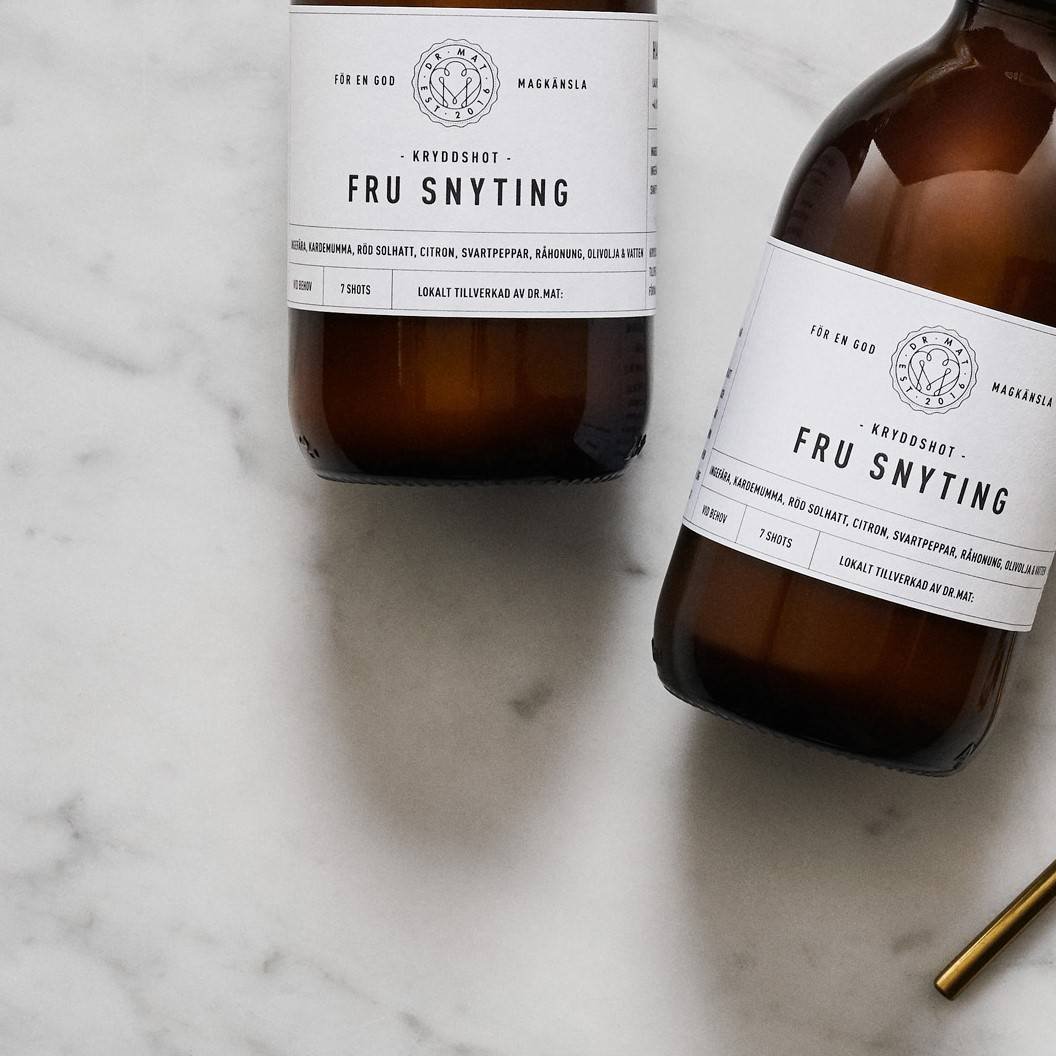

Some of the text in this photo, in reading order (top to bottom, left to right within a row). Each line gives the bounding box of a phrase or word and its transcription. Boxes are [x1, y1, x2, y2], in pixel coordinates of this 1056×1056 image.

[457, 47, 487, 70] MAT
[334, 72, 395, 86] FÖR EN GOD
[518, 76, 588, 90] MAGKÄNSLA
[421, 85, 440, 112] EST
[413, 150, 499, 164] KRYDDSHOT
[348, 174, 568, 207] FRU SNYTING
[357, 242, 373, 255] RÖD
[376, 245, 417, 258] SOLHATT,
[420, 247, 458, 259] CITRON,
[461, 248, 532, 260] SVARTPEPPAR,
[535, 245, 585, 260] RÅHONUNG,
[587, 248, 620, 259] OLIVOLJA
[340, 283, 371, 295] 7 SHOTS
[418, 286, 451, 297] LOKALT
[454, 287, 511, 298] TILLVERKAD
[513, 288, 525, 298] AV
[810, 324, 876, 355] FÖR EN GOD
[944, 337, 969, 365] MAT
[898, 364, 913, 393] EST
[991, 381, 1053, 408] MAGKÄNSLA
[871, 423, 956, 458] KRYDDSHOT
[793, 426, 1009, 515] FRU SNYTING
[709, 508, 728, 524] BEHOV
[732, 475, 785, 506] KARDEMUMMA,
[788, 495, 806, 511] RÖD
[807, 503, 849, 527] SOLHATT,
[852, 518, 889, 540] CITRON,
[892, 530, 957, 559] SVARTPEPPAR,
[960, 547, 1003, 571] RÅHONUNG,
[1004, 560, 1032, 576] OLIVOLJA
[759, 528, 793, 549] 7 SHOTS
[839, 555, 874, 574] LOKALT
[875, 566, 929, 591] TILLVERKAD
[929, 582, 942, 594] AV
